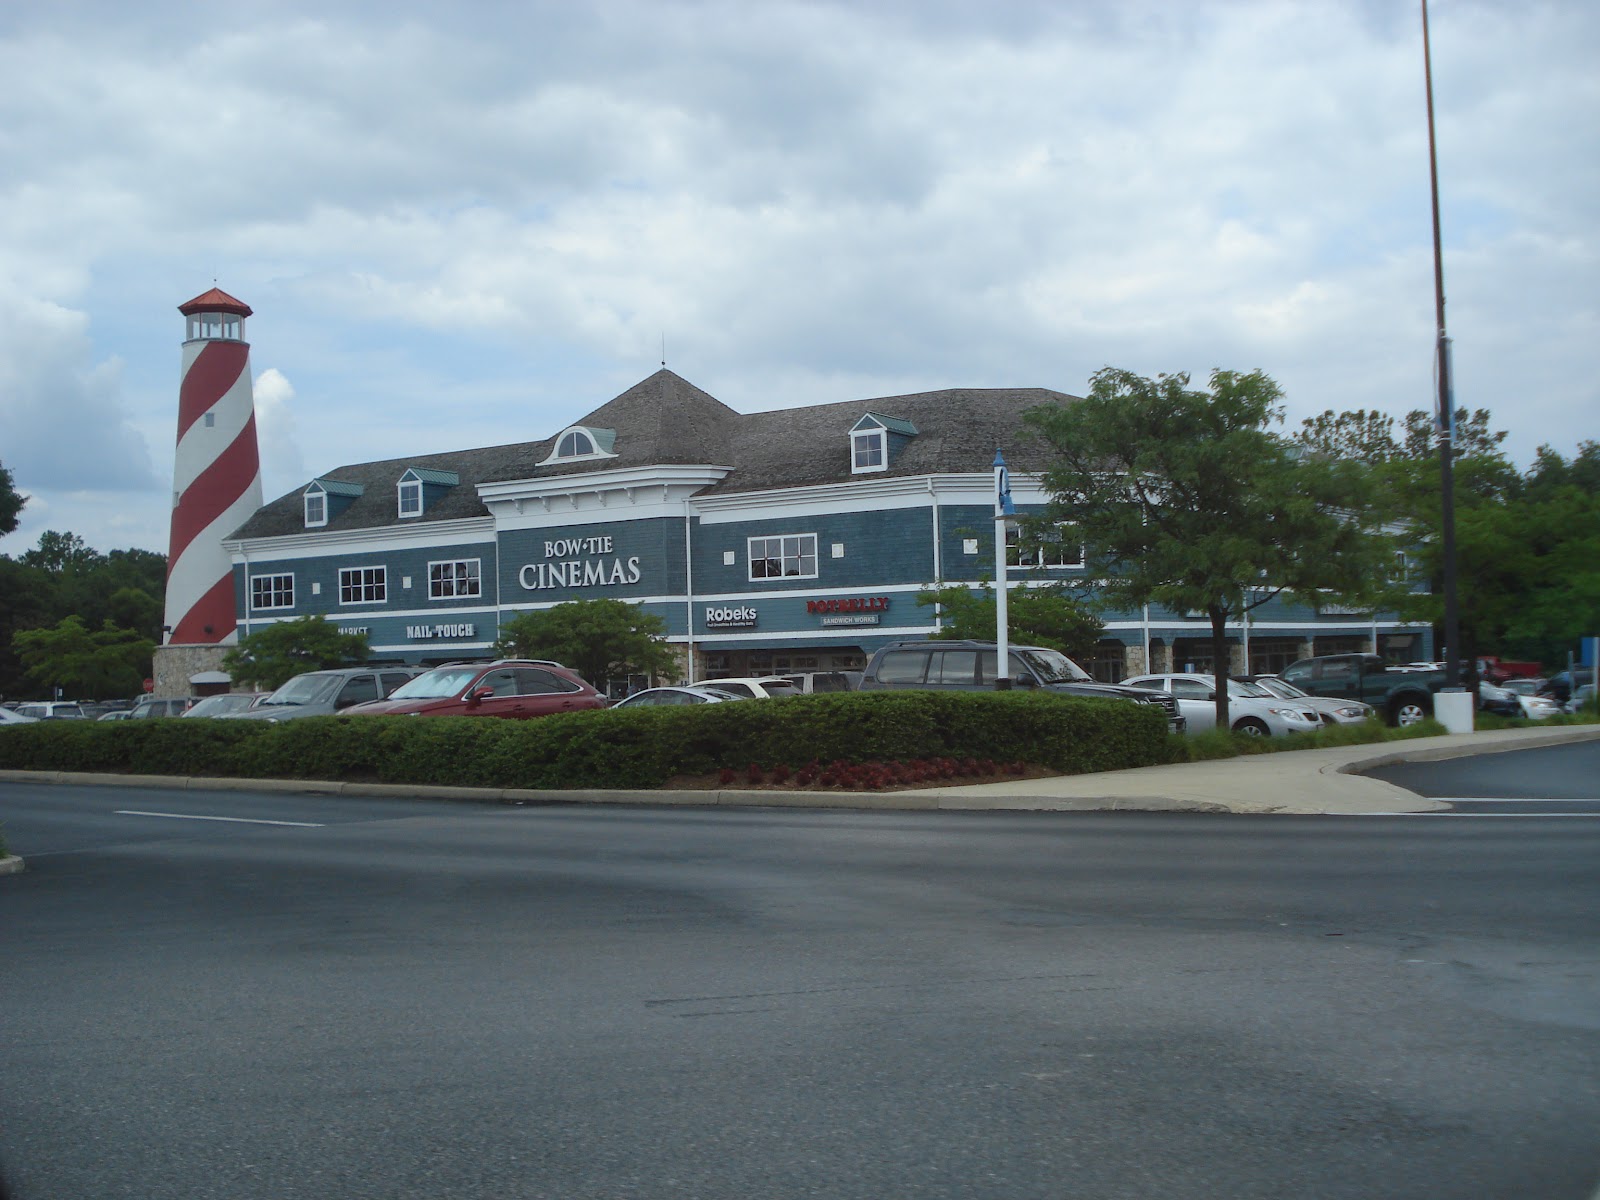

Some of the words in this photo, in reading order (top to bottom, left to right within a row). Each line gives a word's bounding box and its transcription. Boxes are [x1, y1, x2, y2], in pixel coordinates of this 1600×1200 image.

[519, 556, 641, 590] CINEMAS
[706, 605, 757, 622] Robeks
[806, 597, 889, 614] POTBELLY
[822, 616, 853, 625] SANDWICH
[854, 615, 876, 624] WORKS
[406, 625, 433, 639] NAIL
[435, 623, 475, 638] TOUCH
